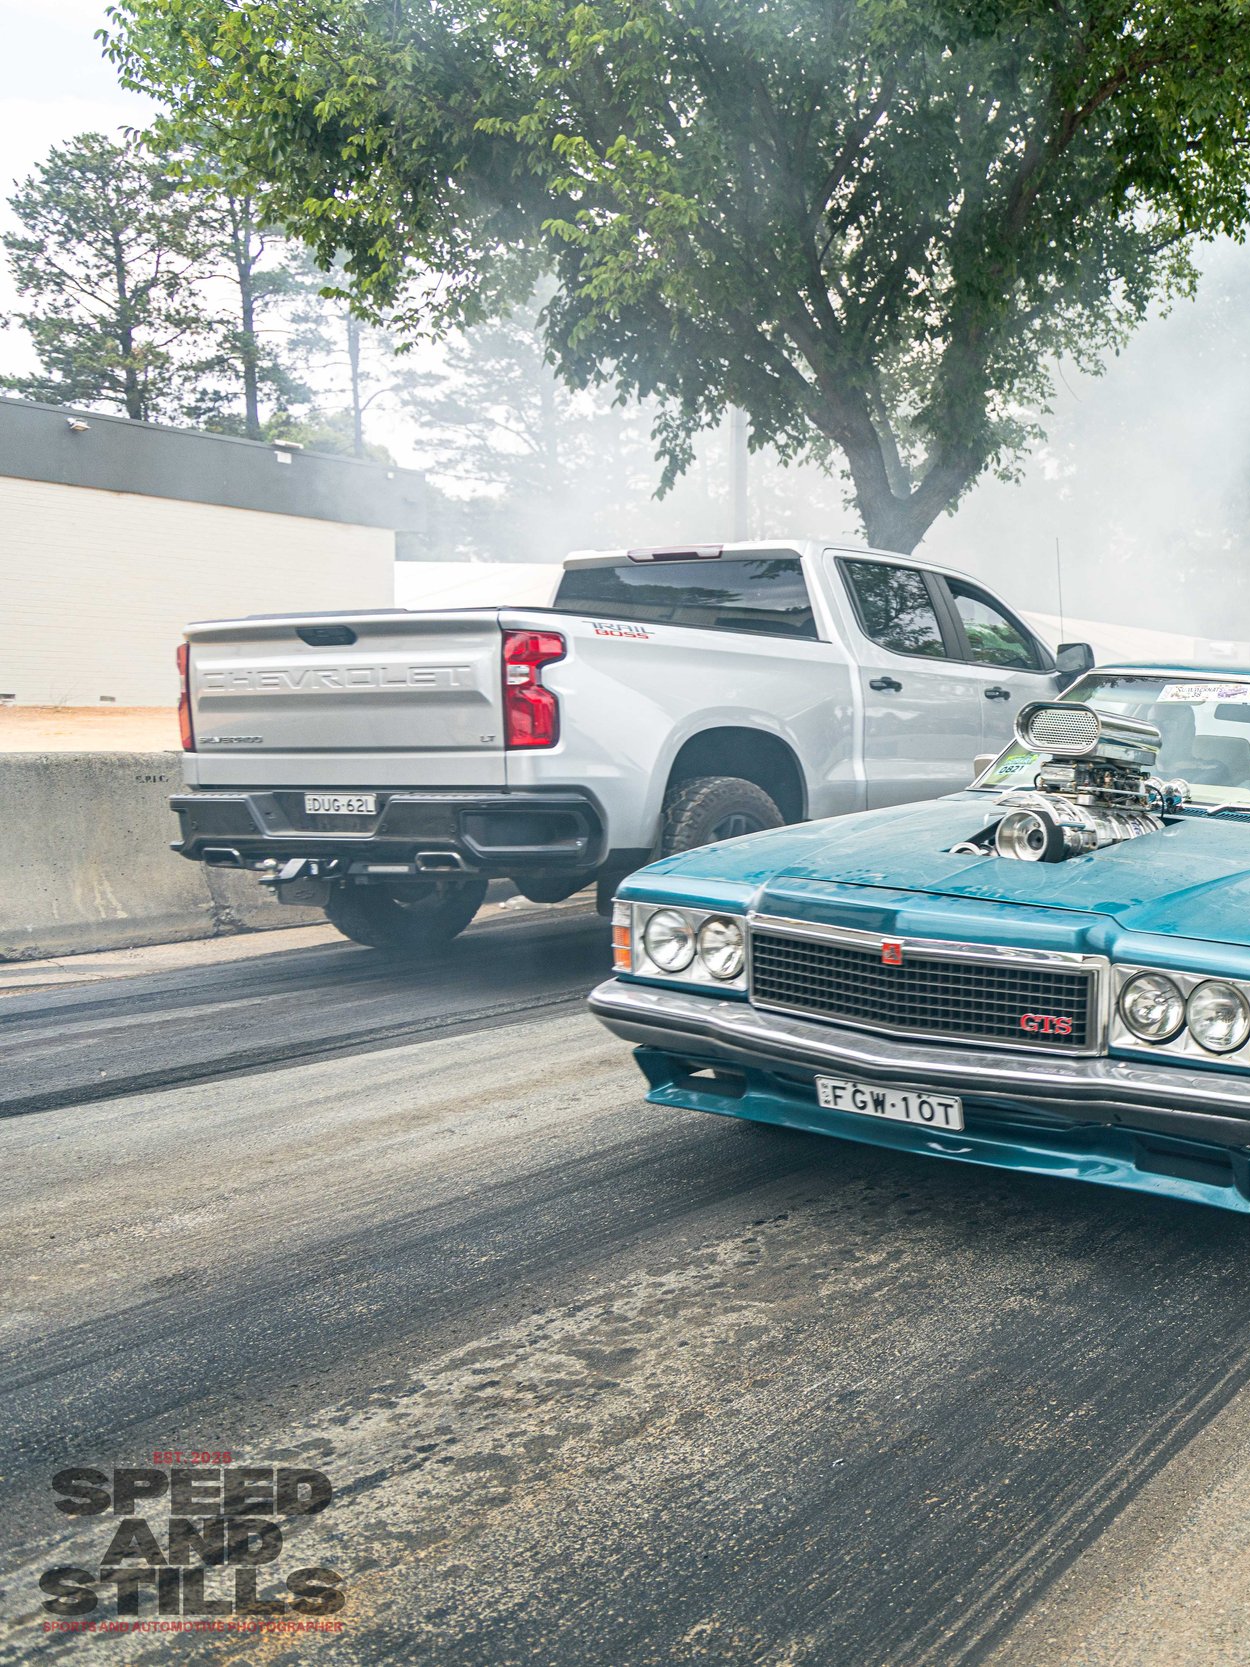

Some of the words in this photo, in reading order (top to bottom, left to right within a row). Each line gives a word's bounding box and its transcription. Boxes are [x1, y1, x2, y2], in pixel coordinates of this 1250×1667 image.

[581, 620, 655, 635] TRAIL
[595, 629, 649, 640] BOSS
[202, 665, 471, 692] CHEVROLET
[199, 735, 264, 744] SILVERADO
[479, 735, 496, 743] LT
[998, 765, 1025, 774] 0821
[1020, 1013, 1072, 1035] GTS
